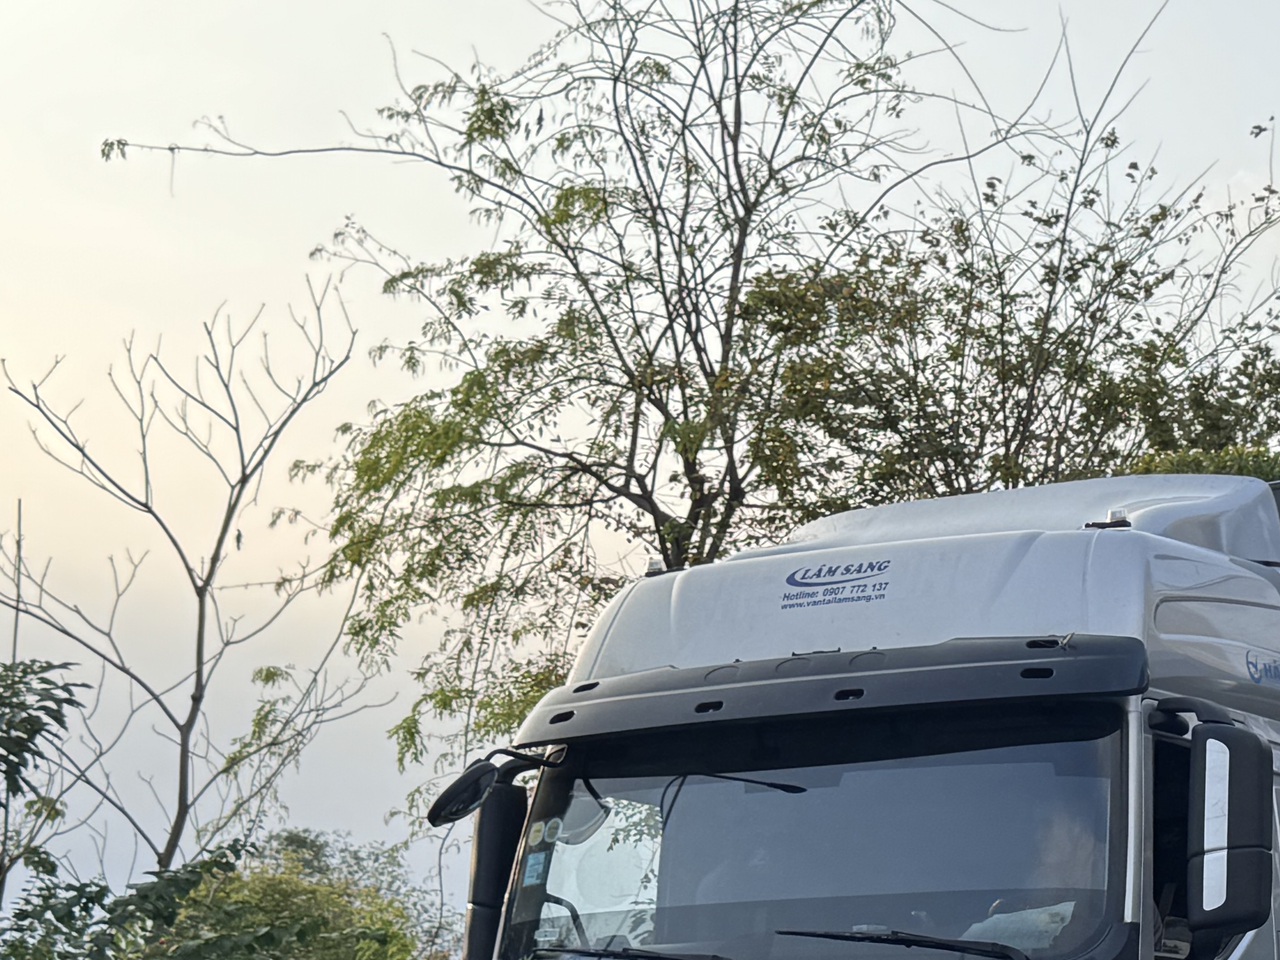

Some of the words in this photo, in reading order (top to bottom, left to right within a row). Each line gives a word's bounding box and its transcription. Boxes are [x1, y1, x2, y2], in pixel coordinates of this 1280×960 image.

[800, 564, 841, 581] LÂM
[841, 560, 891, 576] SANG
[781, 593, 886, 610] www.vantailamsang.vn
[782, 591, 819, 602] Hotline:
[822, 586, 846, 597] 0907
[850, 583, 867, 594] 772
[871, 582, 889, 592] 137
